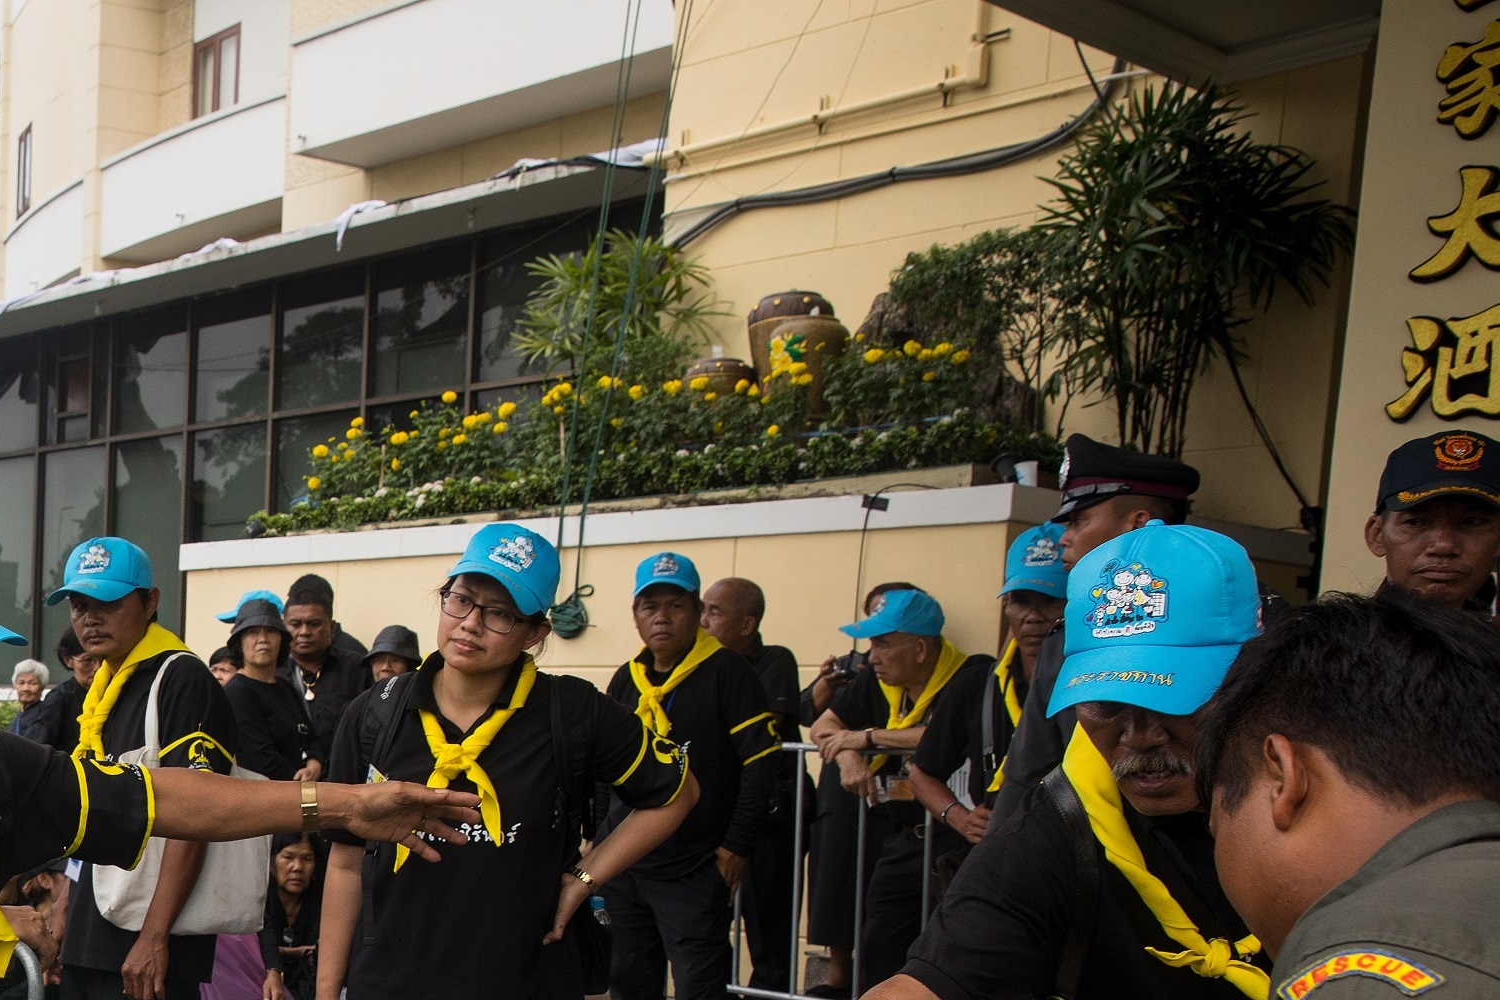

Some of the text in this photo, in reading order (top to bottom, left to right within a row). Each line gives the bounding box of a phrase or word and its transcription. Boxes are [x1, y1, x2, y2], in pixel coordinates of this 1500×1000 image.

[1384, 0, 1500, 422] 家大酒
[1064, 669, 1176, 689] พระราชทาน
[1291, 953, 1426, 999] RESCUE
